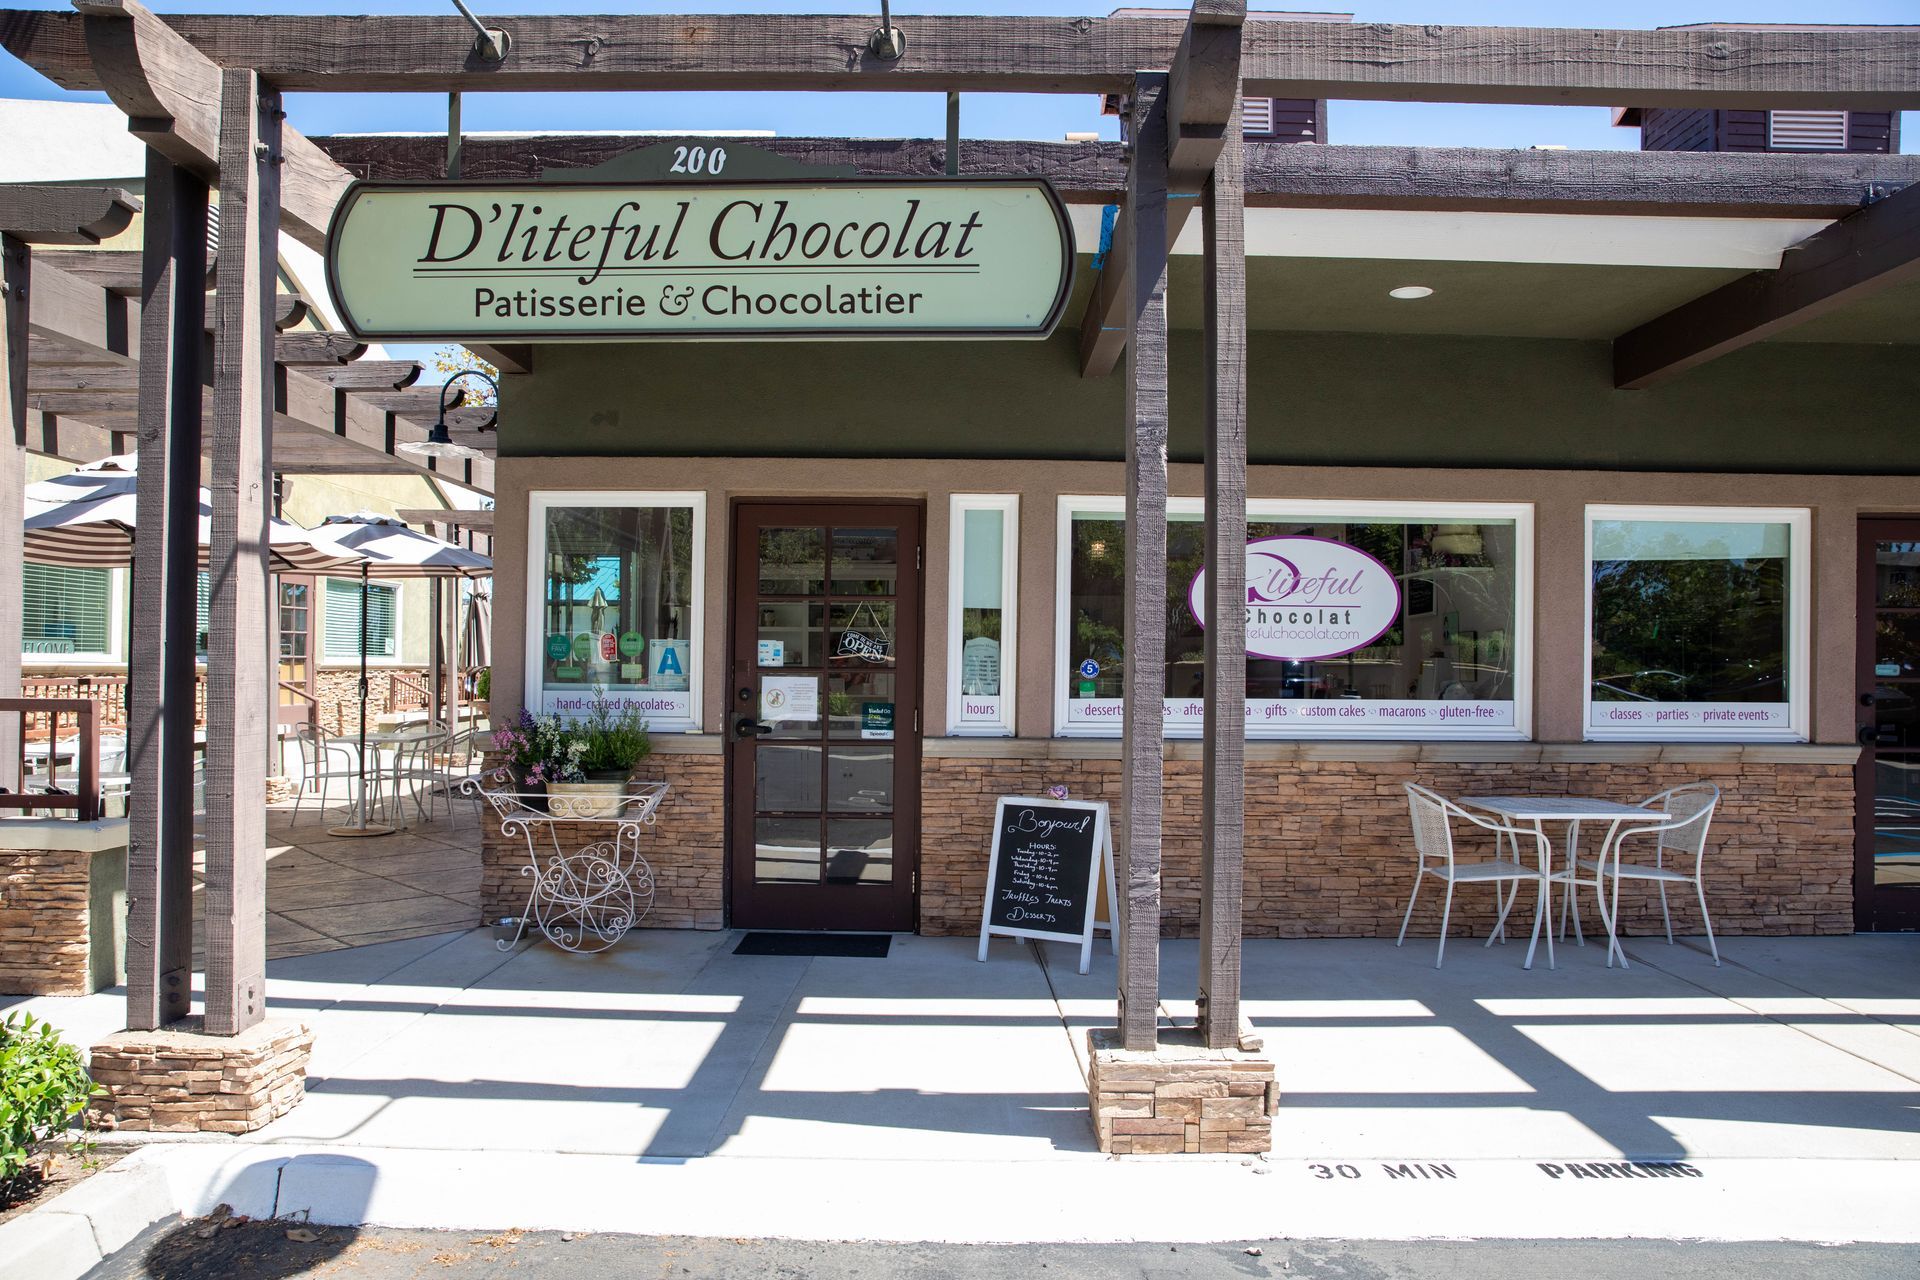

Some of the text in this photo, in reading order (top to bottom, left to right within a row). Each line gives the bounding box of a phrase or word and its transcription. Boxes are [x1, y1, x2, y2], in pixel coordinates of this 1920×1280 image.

[670, 146, 726, 175] 200
[417, 200, 983, 285] D'liteful Chocolat
[474, 284, 922, 317] Patisserie & Chocolatier
[23, 642, 70, 653] ELCOME
[845, 637, 884, 660] OPEN
[657, 647, 683, 674] A
[1087, 664, 1093, 674] 5
[623, 697, 675, 710] chocolates
[966, 701, 995, 715] hours
[1265, 703, 1287, 719] gifts
[1301, 705, 1336, 717] custom
[1339, 704, 1366, 717] cakes
[1379, 707, 1426, 717] macarons
[1440, 705, 1494, 720] gluten-free
[1610, 707, 1769, 723] classes parties private events
[1308, 1161, 1704, 1180] 30 MIN PARKING
